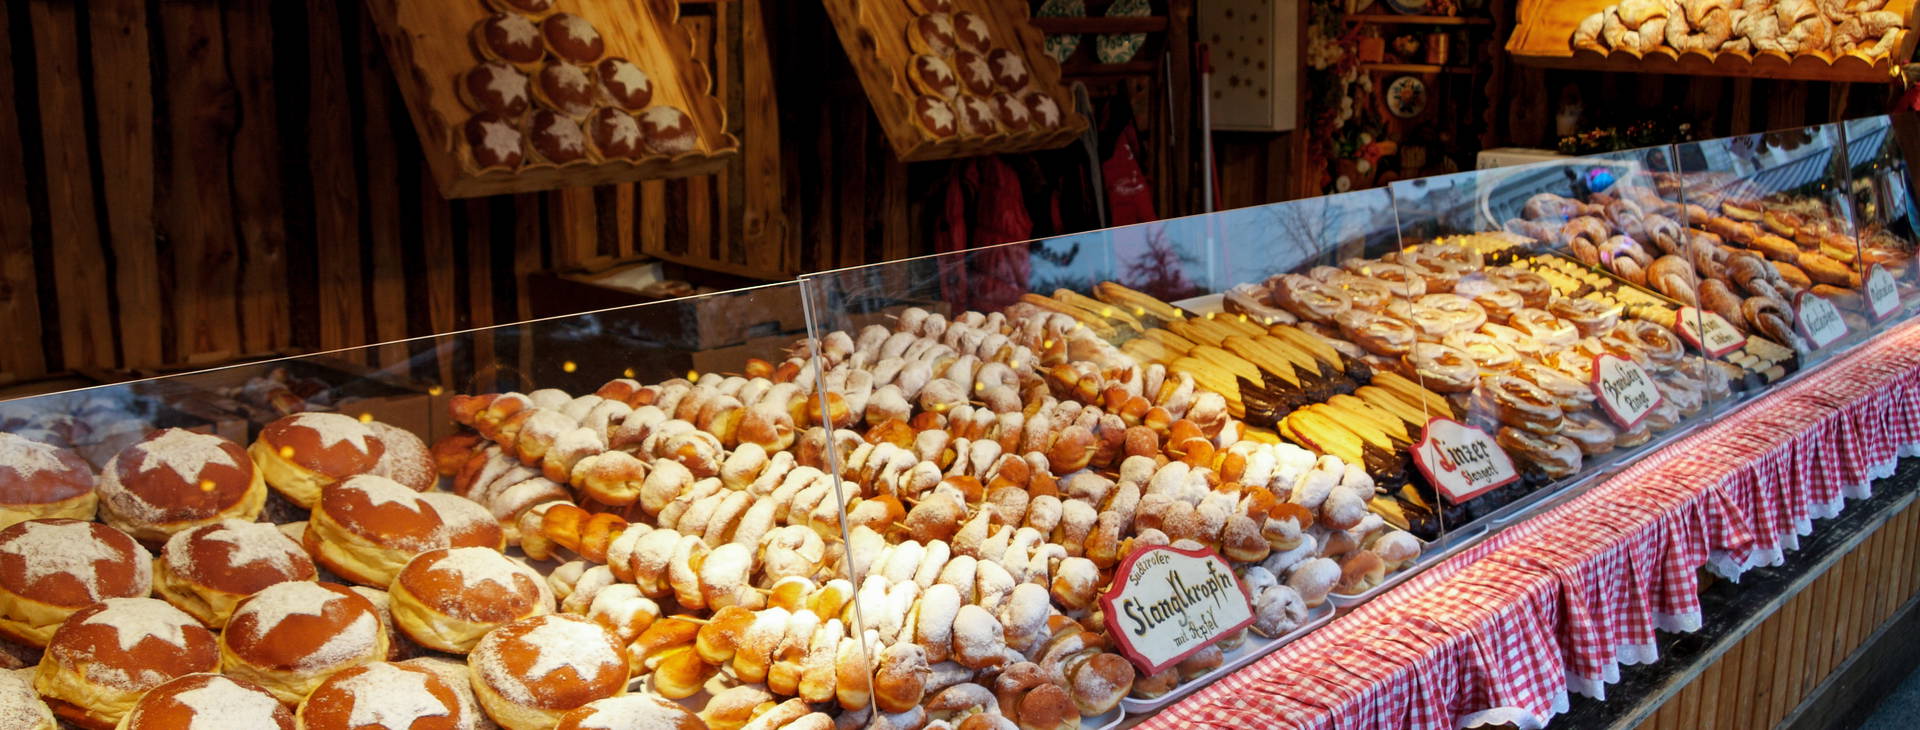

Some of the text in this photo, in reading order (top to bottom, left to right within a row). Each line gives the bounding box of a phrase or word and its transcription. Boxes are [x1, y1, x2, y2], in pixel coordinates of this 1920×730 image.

[1430, 437, 1490, 472] Linzer
[1123, 560, 1233, 637] Stanglkropfn
[1173, 632, 1189, 647] mit
